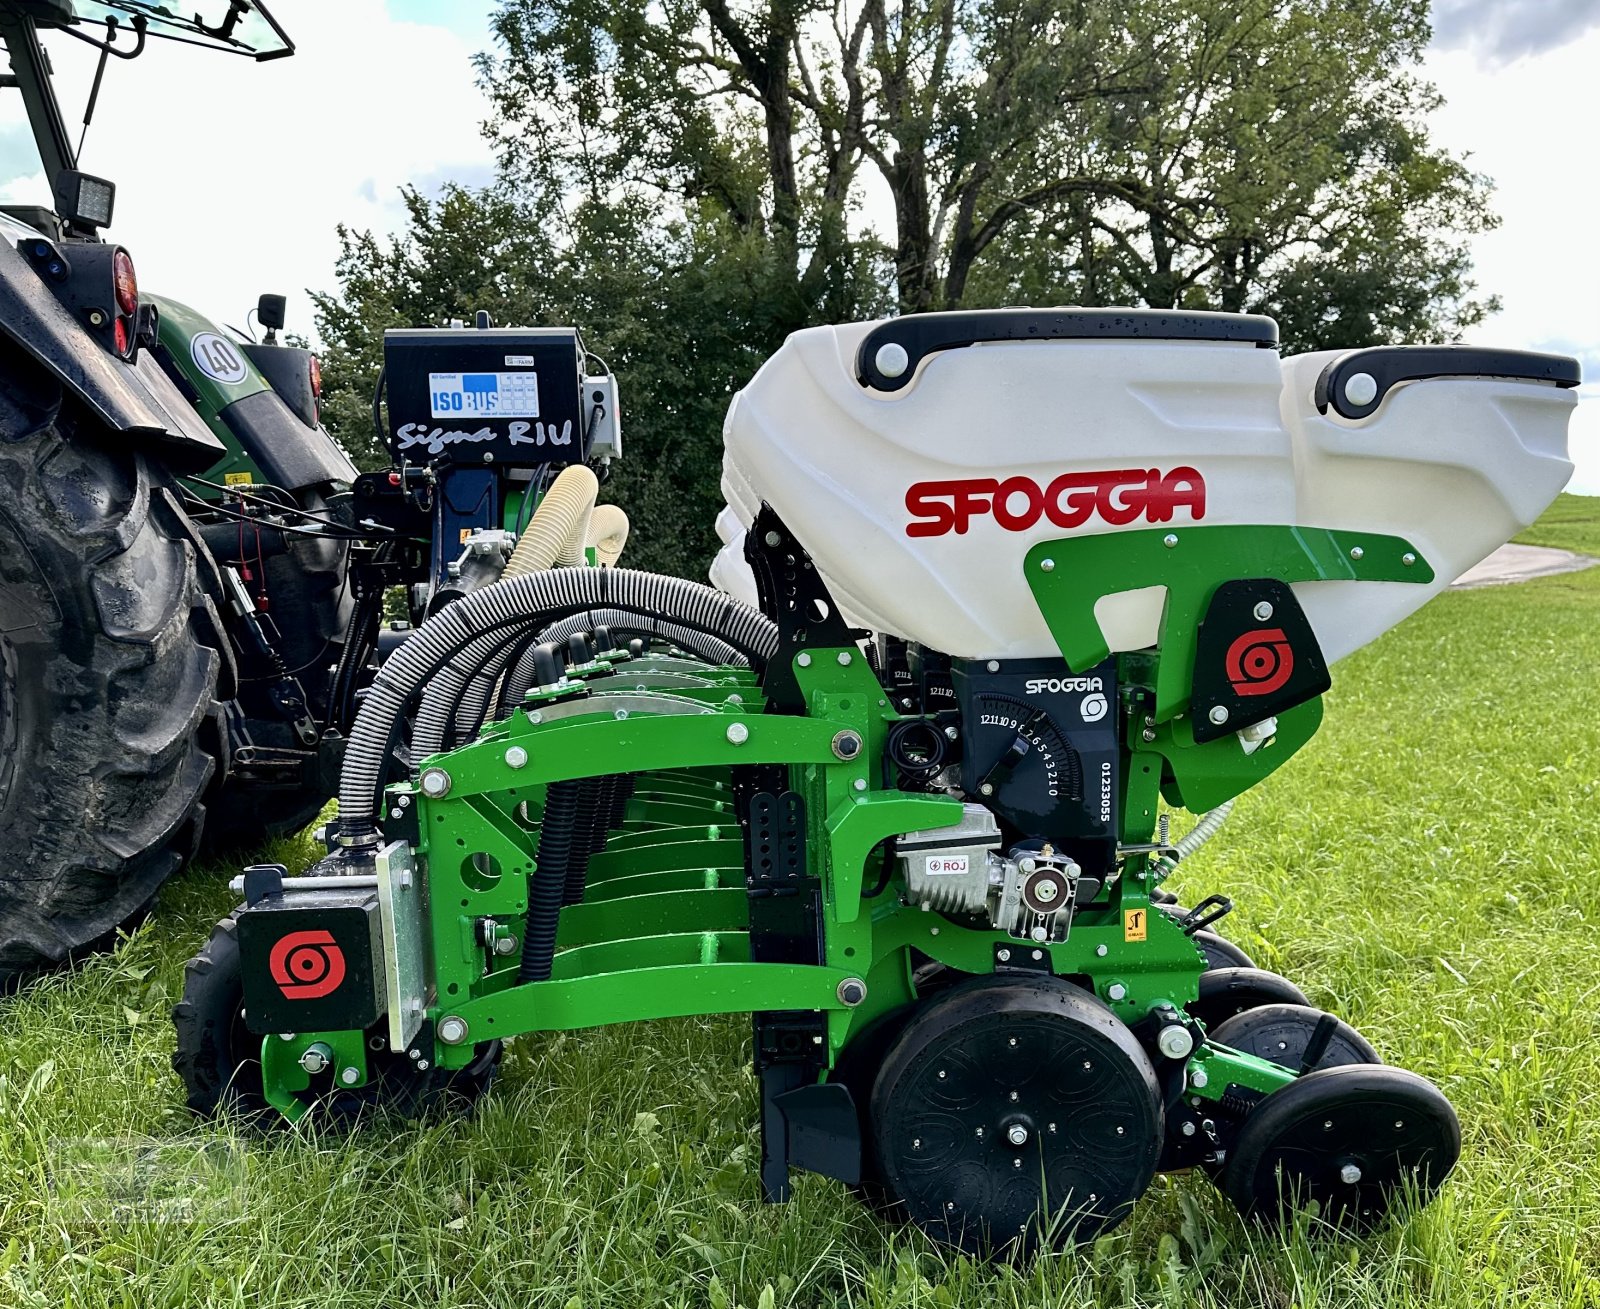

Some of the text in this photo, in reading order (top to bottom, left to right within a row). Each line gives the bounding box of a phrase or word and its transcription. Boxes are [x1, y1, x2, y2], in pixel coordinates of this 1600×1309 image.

[200, 340, 240, 375] 40
[397, 420, 572, 454] Sigma RIU
[905, 466, 1206, 537] SFOGGIA
[1025, 677, 1103, 694] SFOGGIA
[1101, 762, 1111, 822] 01233055
[943, 862, 966, 871] ROJ
